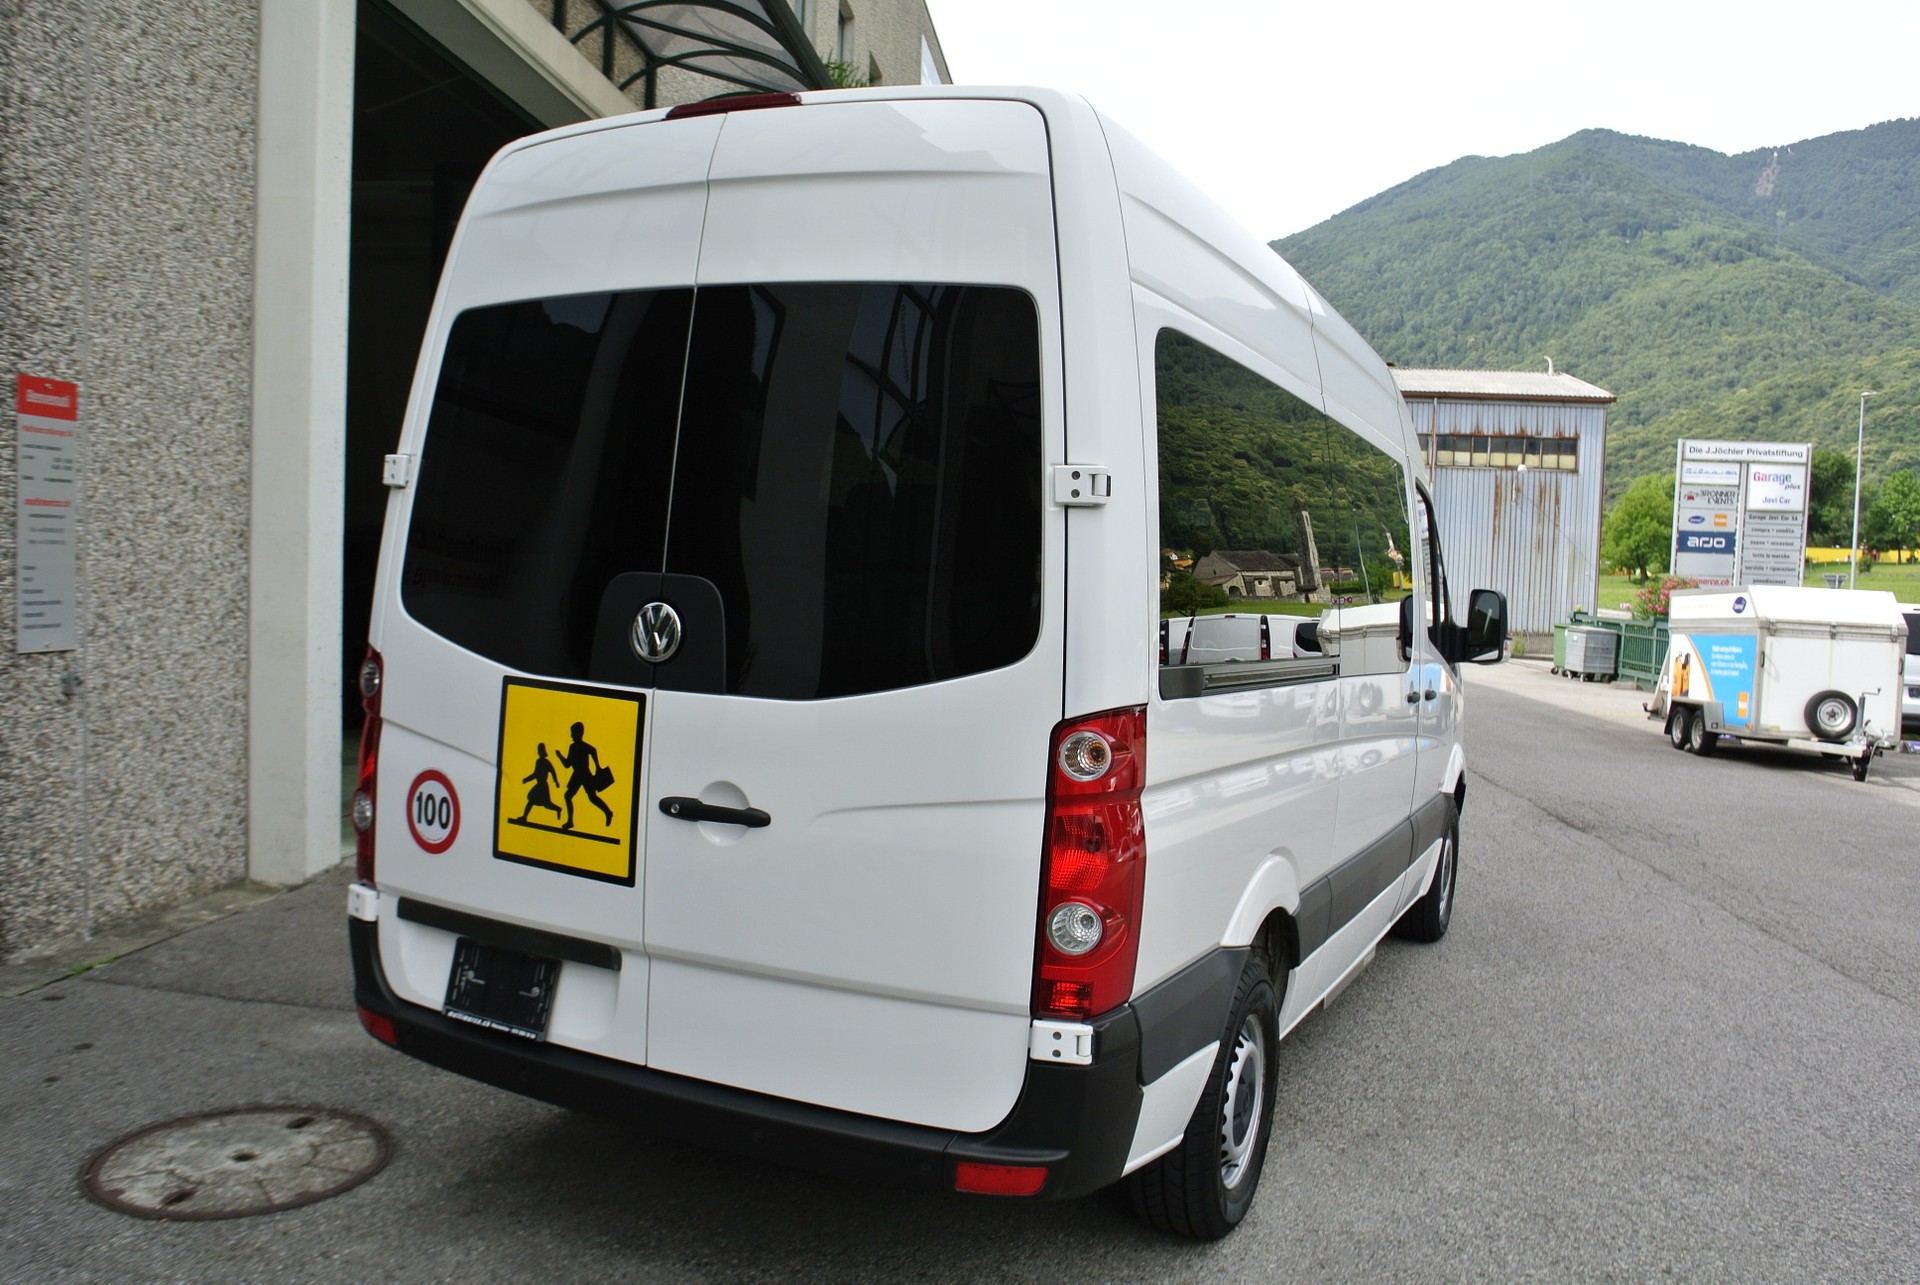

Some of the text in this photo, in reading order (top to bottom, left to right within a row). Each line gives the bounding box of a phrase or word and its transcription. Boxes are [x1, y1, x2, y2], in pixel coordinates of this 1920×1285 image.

[1689, 446, 1703, 454] Die
[1746, 448, 1803, 459] Privatstiftung
[1753, 471, 1792, 485] Garage
[1784, 483, 1801, 491] plus
[1778, 496, 1791, 504] Car
[632, 602, 681, 662] VW
[416, 791, 451, 830] 100
